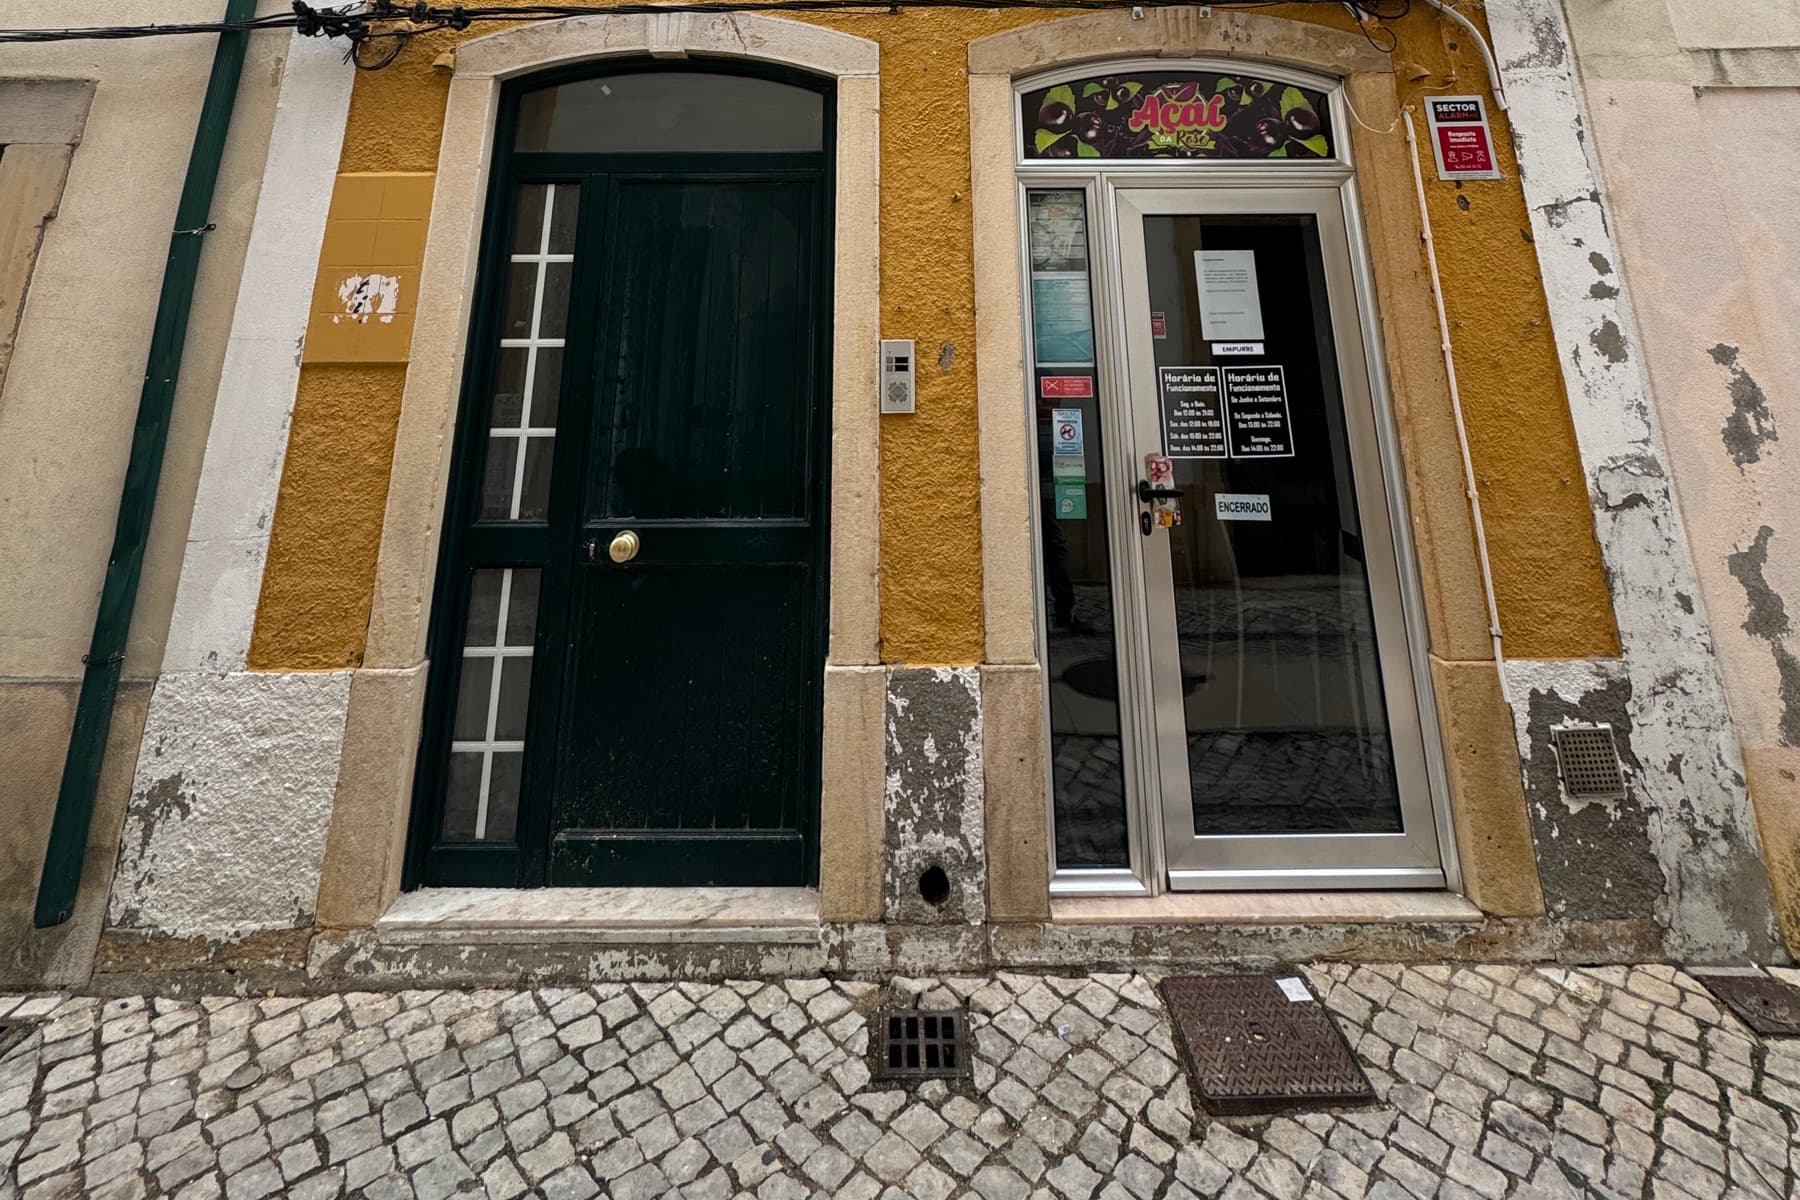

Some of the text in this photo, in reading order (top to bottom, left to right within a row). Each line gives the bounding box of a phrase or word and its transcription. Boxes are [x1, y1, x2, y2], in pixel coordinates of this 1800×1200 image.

[1436, 103, 1476, 112] SECTOR
[1128, 94, 1227, 134] Açaí
[1165, 373, 1216, 382] Horário de
[1228, 372, 1279, 382] Horário de
[1166, 384, 1217, 392] Funcionamento
[1229, 383, 1280, 392] Funcionamento
[1218, 501, 1269, 513] ENCERRADO
